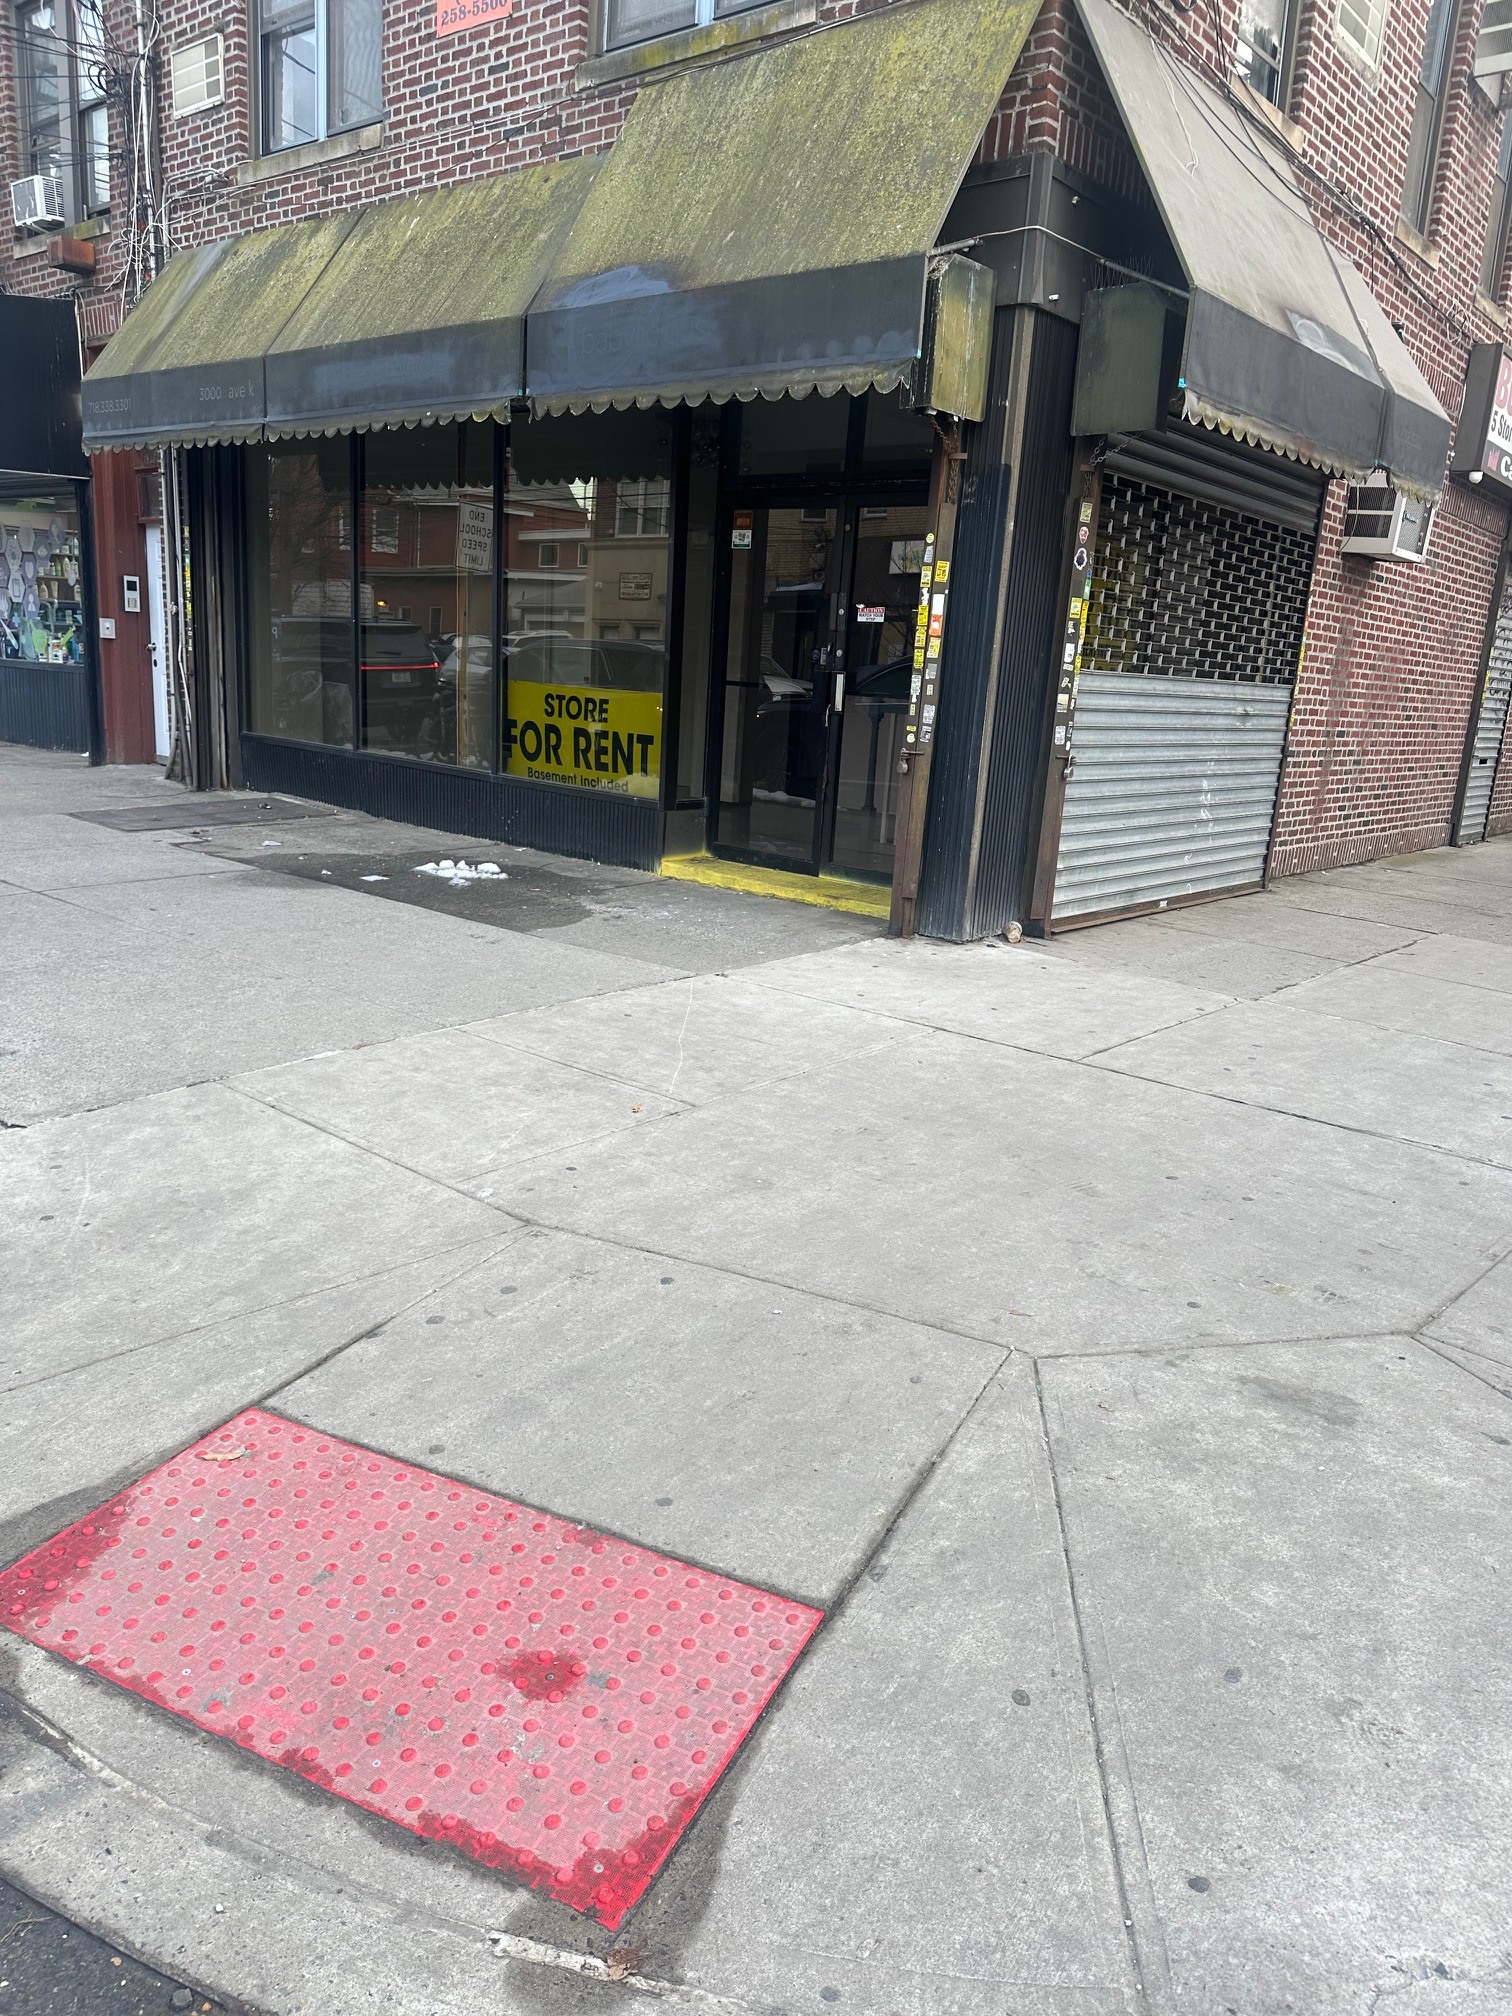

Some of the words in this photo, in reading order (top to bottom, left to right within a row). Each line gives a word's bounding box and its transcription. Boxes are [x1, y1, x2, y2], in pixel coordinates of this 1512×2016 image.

[199, 386, 222, 401] 3000
[228, 386, 246, 399] ave
[1494, 356, 1512, 417] B
[88, 397, 132, 414] 718.338.3301
[1491, 409, 1499, 432] 5
[544, 693, 610, 723] STORE
[503, 718, 563, 766] FOR
[573, 727, 655, 777] RENT
[527, 766, 577, 785] Basement
[580, 775, 629, 793] Included
